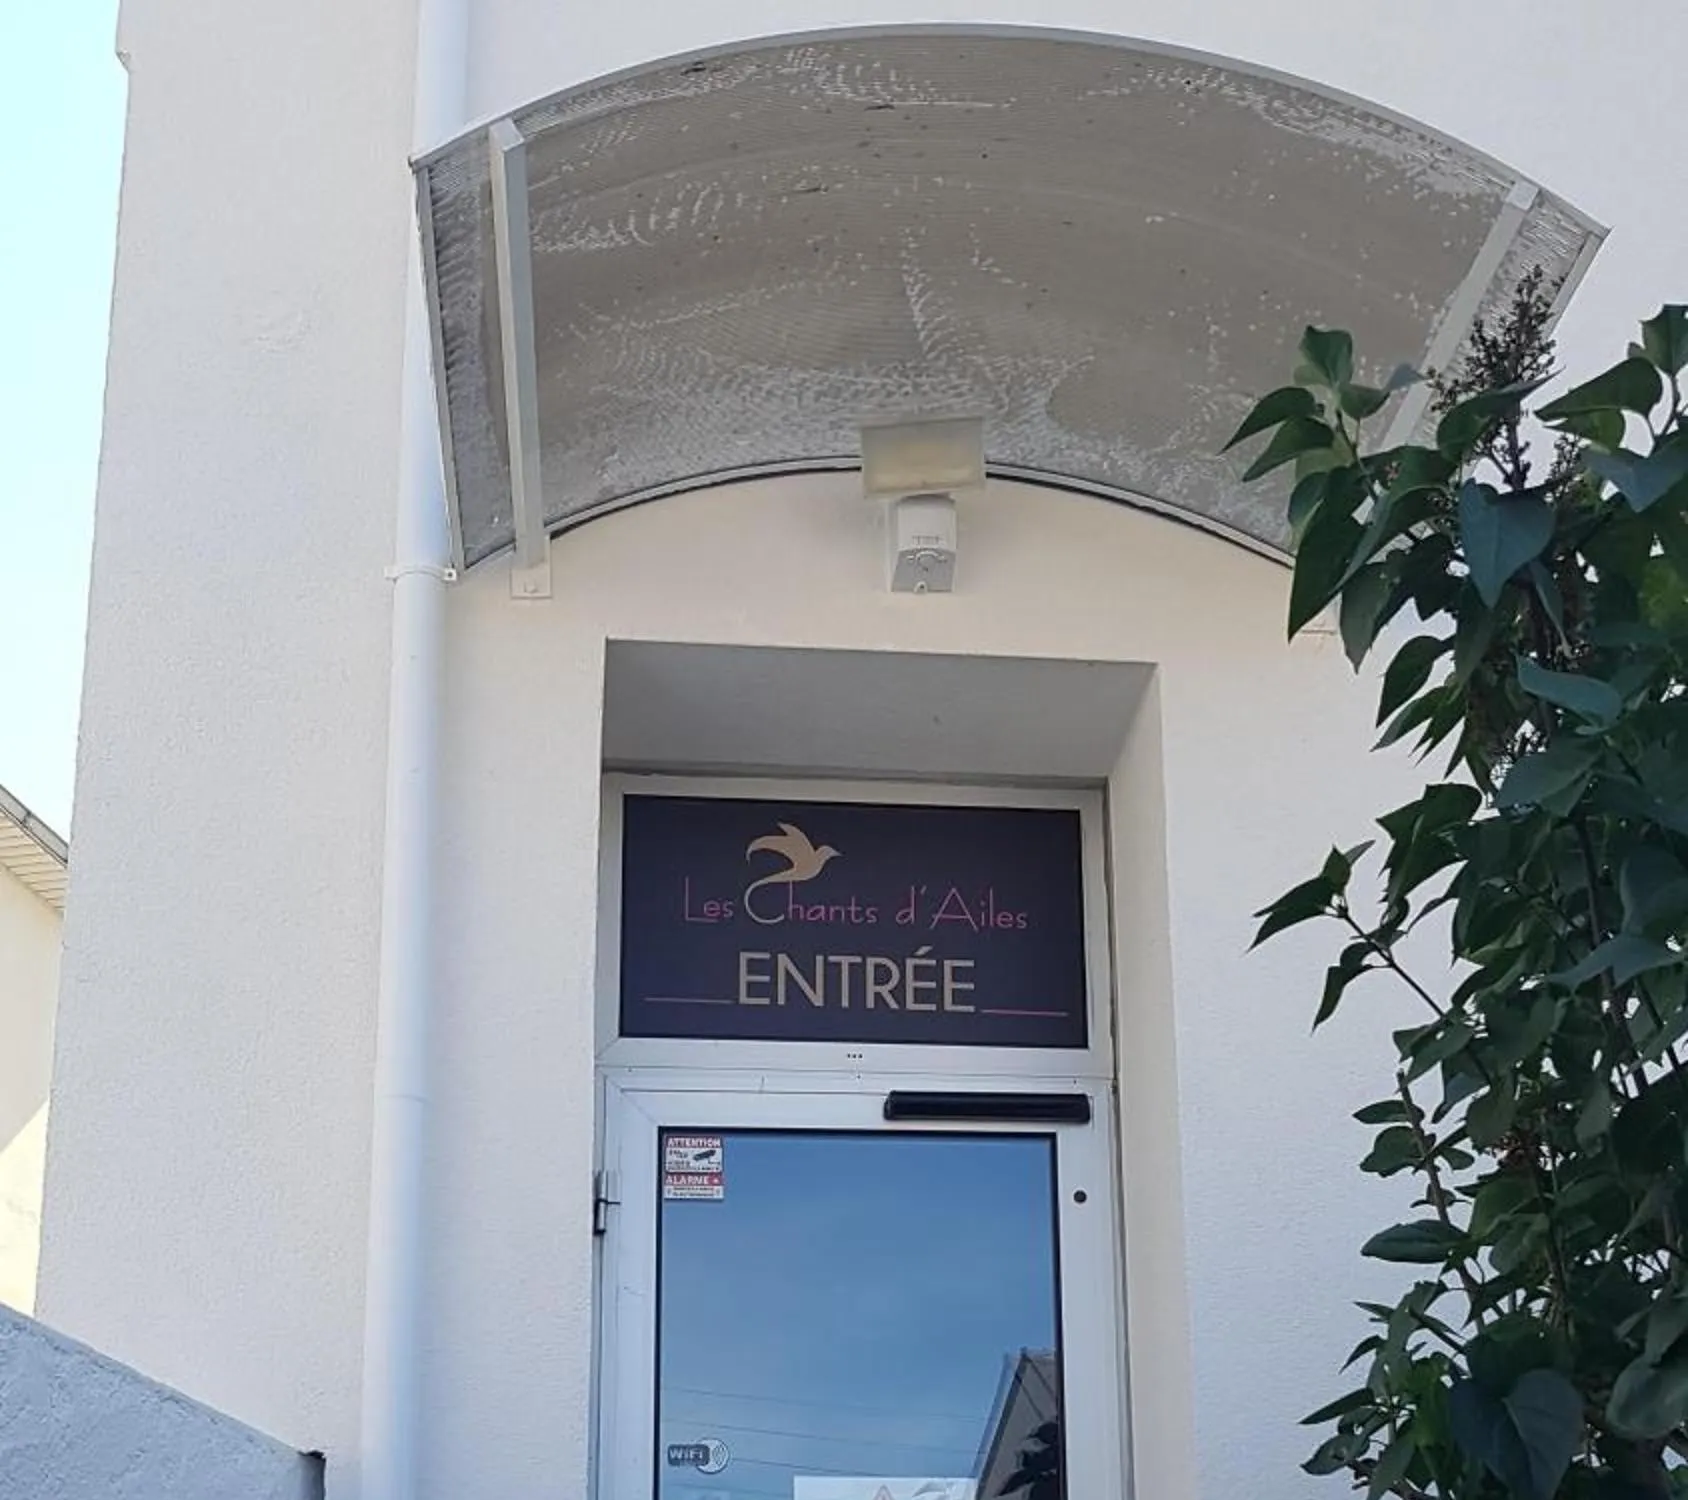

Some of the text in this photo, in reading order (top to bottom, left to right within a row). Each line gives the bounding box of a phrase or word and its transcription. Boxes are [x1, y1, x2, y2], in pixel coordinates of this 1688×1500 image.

[683, 877, 735, 923] Les
[744, 877, 878, 925] Chants
[738, 945, 976, 1013] ENTRÉE
[667, 1137, 721, 1148] ATTENTION
[665, 1174, 709, 1186] ALARME
